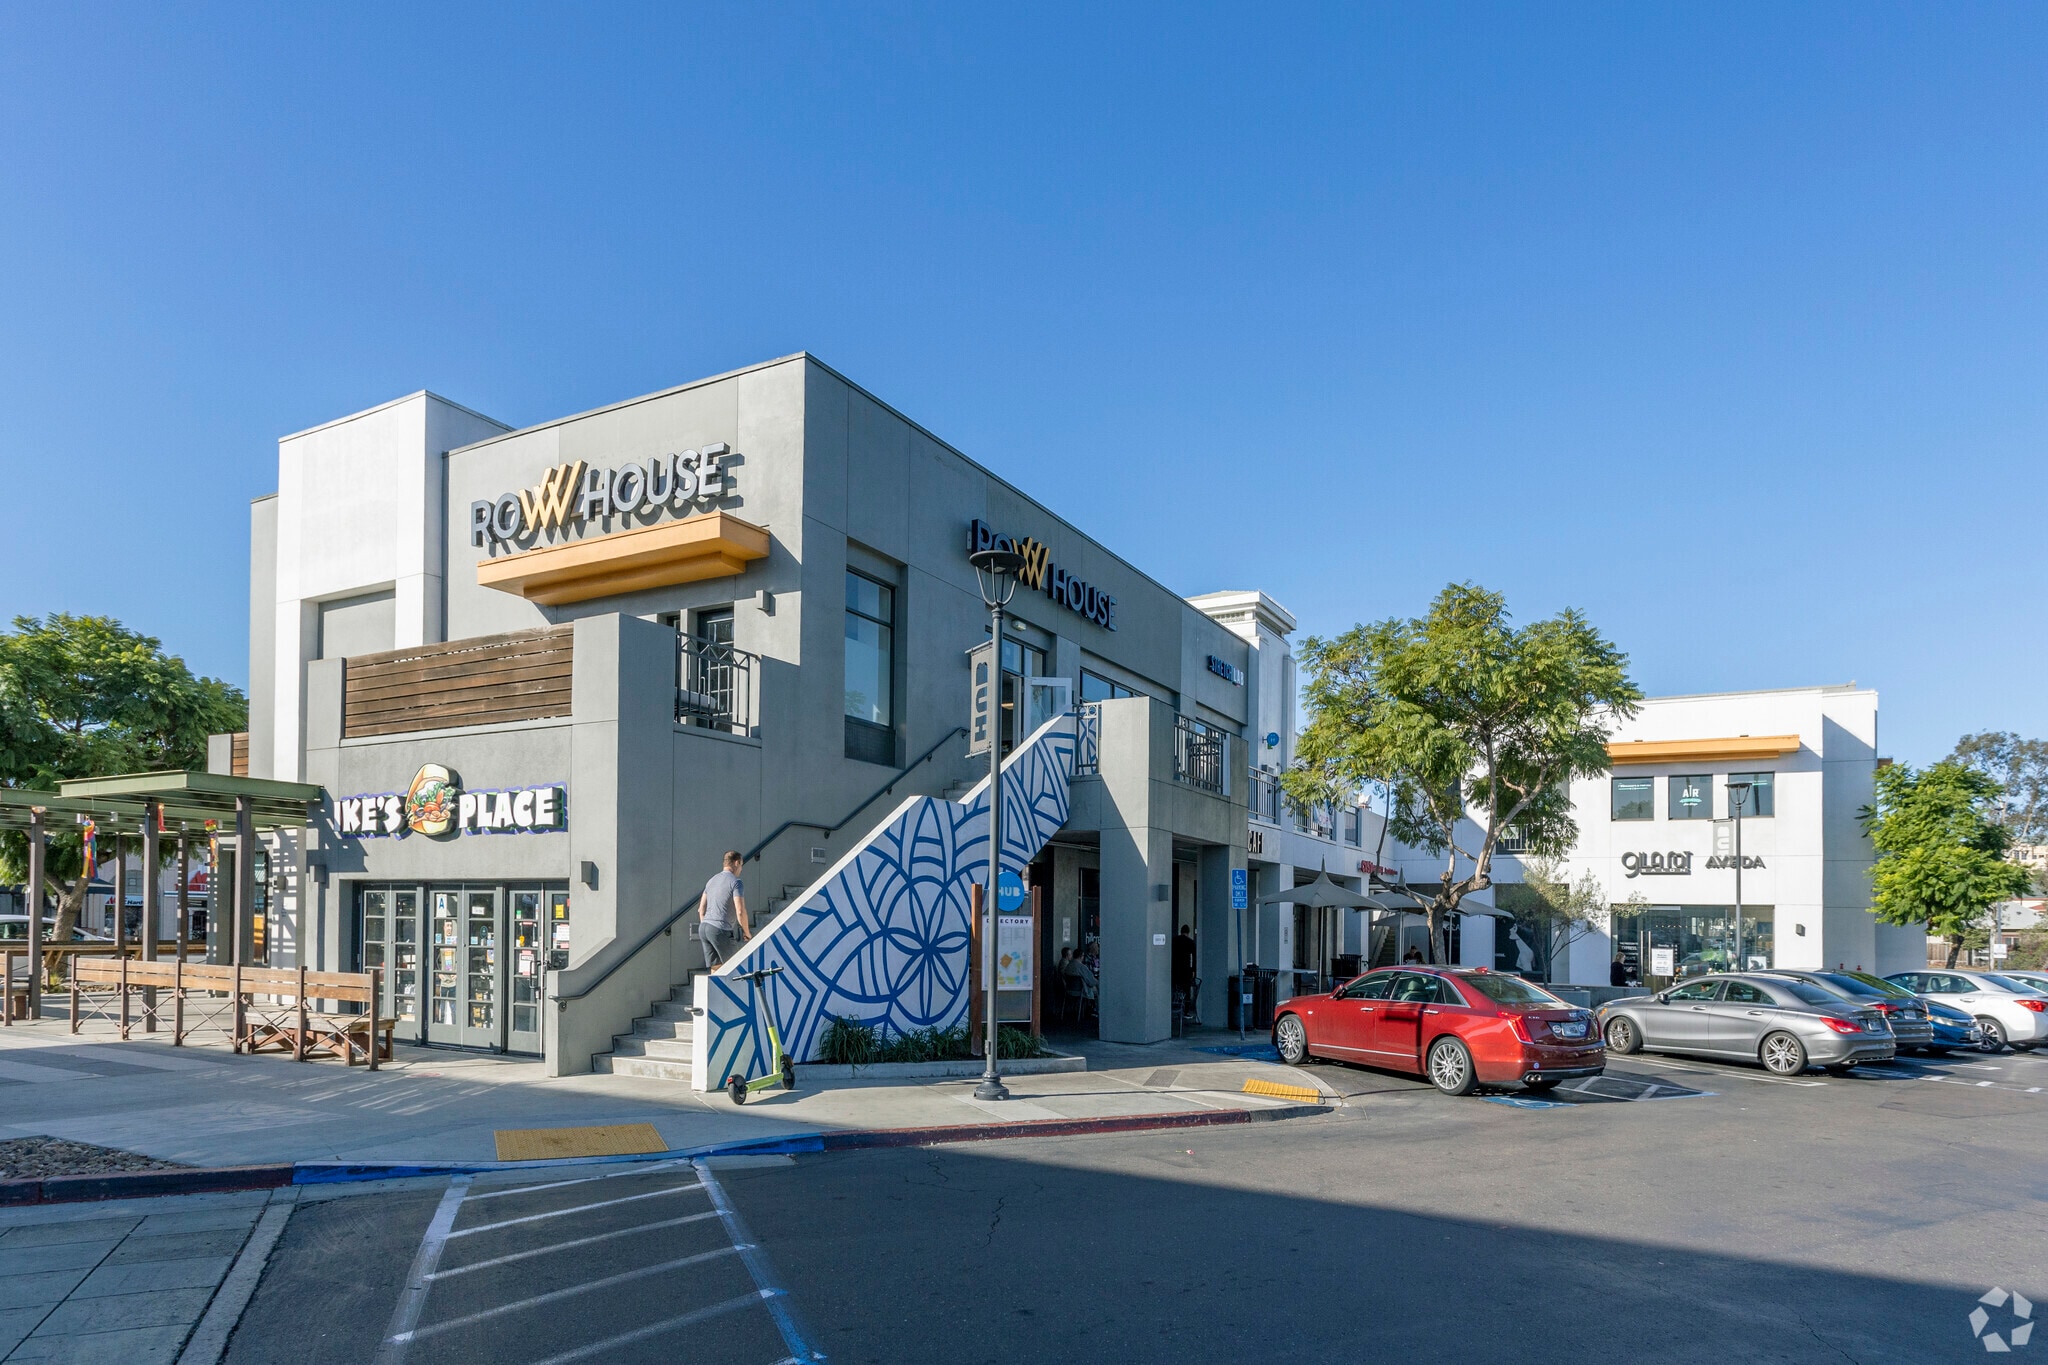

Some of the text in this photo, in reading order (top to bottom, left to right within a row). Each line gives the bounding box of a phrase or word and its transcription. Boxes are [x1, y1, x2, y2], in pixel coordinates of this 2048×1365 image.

[583, 442, 730, 522] HOUSE
[1048, 563, 1118, 632] HOUSE
[333, 786, 560, 833] IKE'S PLACE
[438, 897, 445, 909] A
